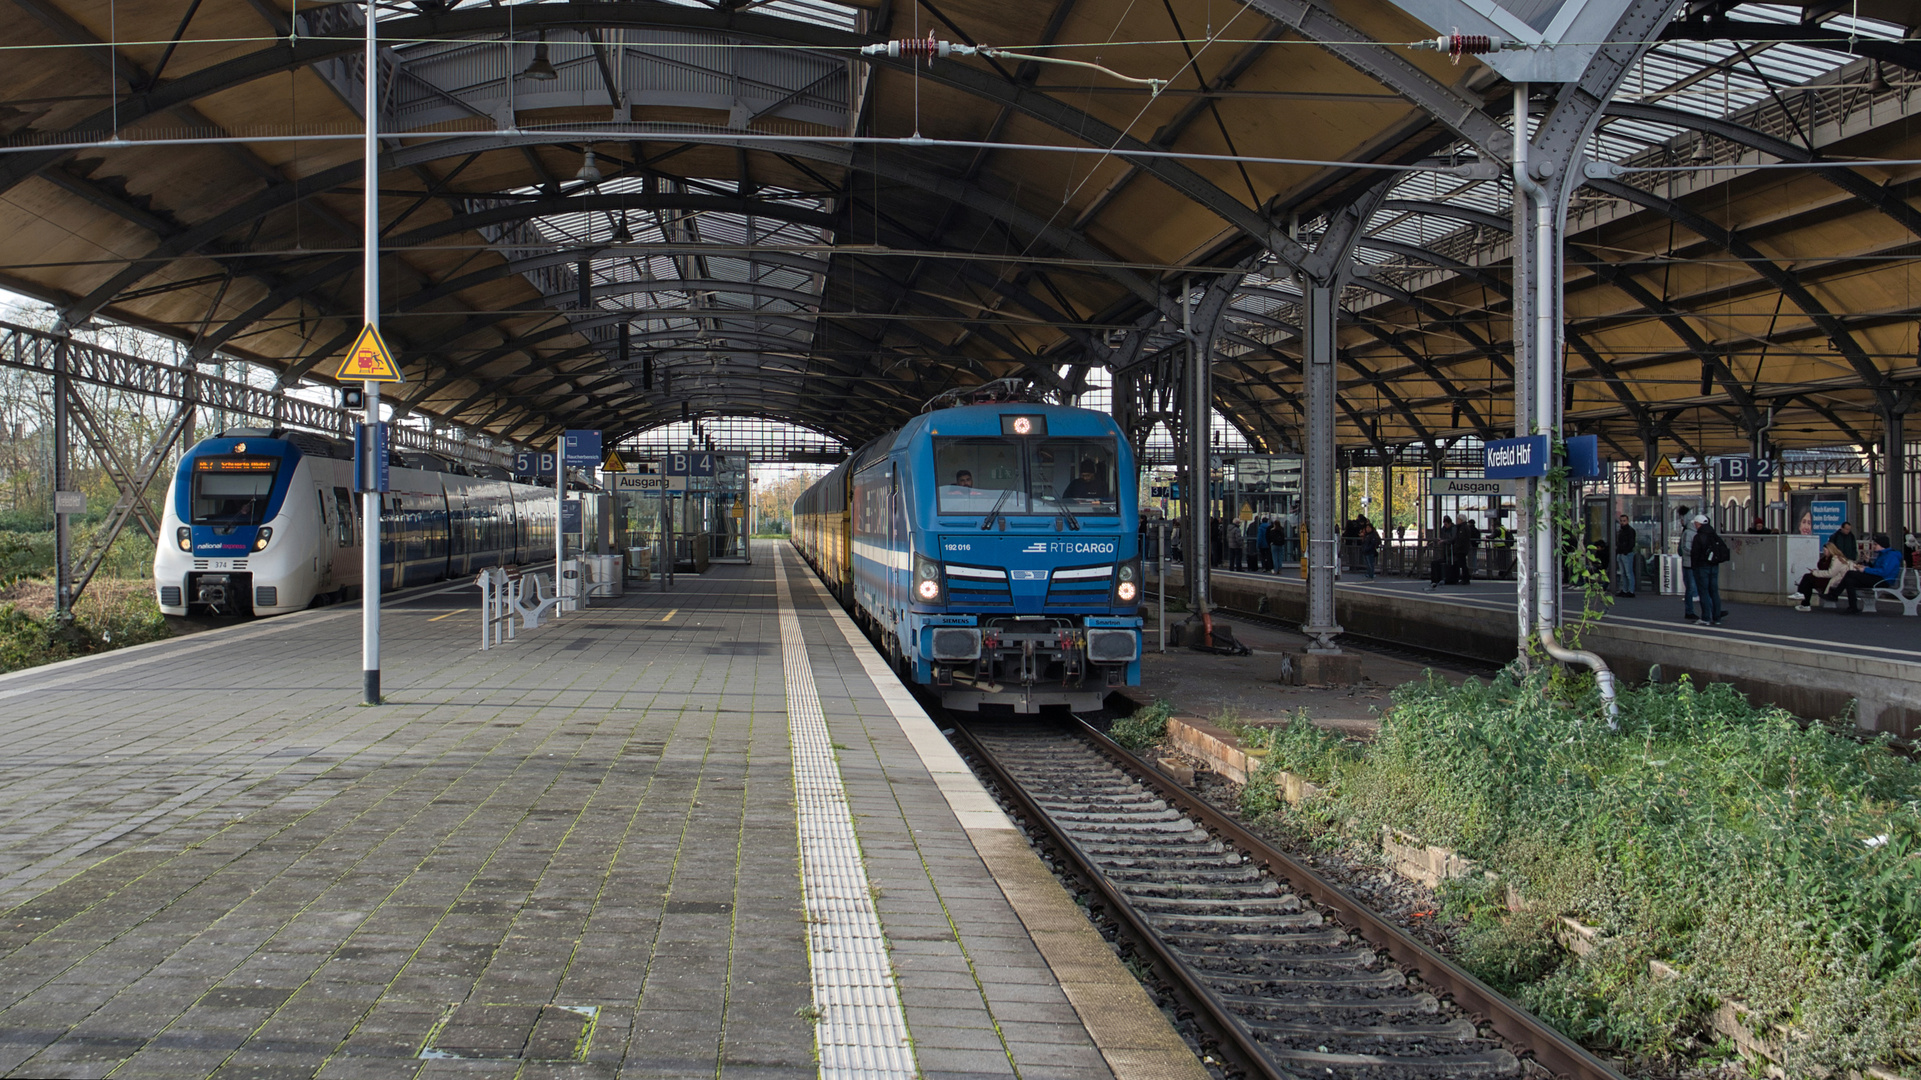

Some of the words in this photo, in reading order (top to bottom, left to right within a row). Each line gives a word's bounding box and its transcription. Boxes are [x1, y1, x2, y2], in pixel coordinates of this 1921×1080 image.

[517, 454, 528, 471] 5
[541, 454, 553, 471] B
[674, 454, 686, 472] B
[699, 454, 711, 472] 4
[1487, 445, 1515, 468] Krefeld
[1516, 443, 1531, 465] Hbf
[1730, 459, 1743, 477] B
[1757, 459, 1770, 477] 2
[620, 476, 670, 488] Ausgang
[1448, 480, 1500, 493] Ausgang
[1152, 486, 1158, 496] 3
[1050, 543, 1074, 552] RTB
[1075, 543, 1114, 553] CARGO
